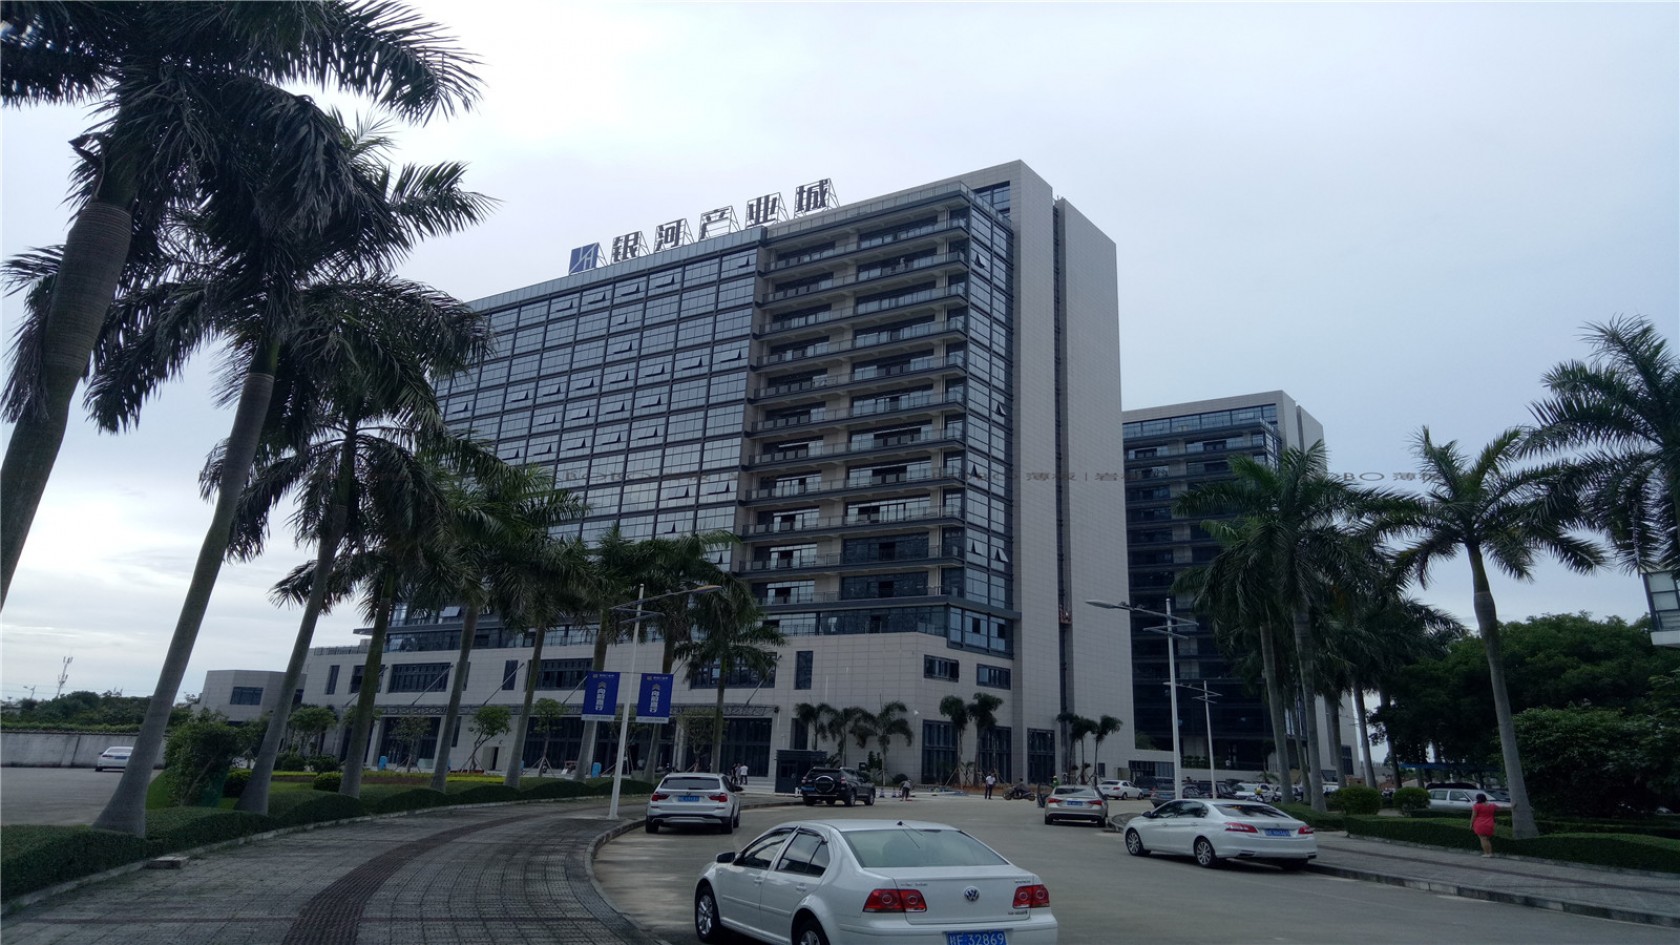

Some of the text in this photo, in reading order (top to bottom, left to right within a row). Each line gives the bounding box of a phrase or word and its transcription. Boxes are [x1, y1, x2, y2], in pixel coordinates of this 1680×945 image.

[612, 179, 829, 263] 银河产业城
